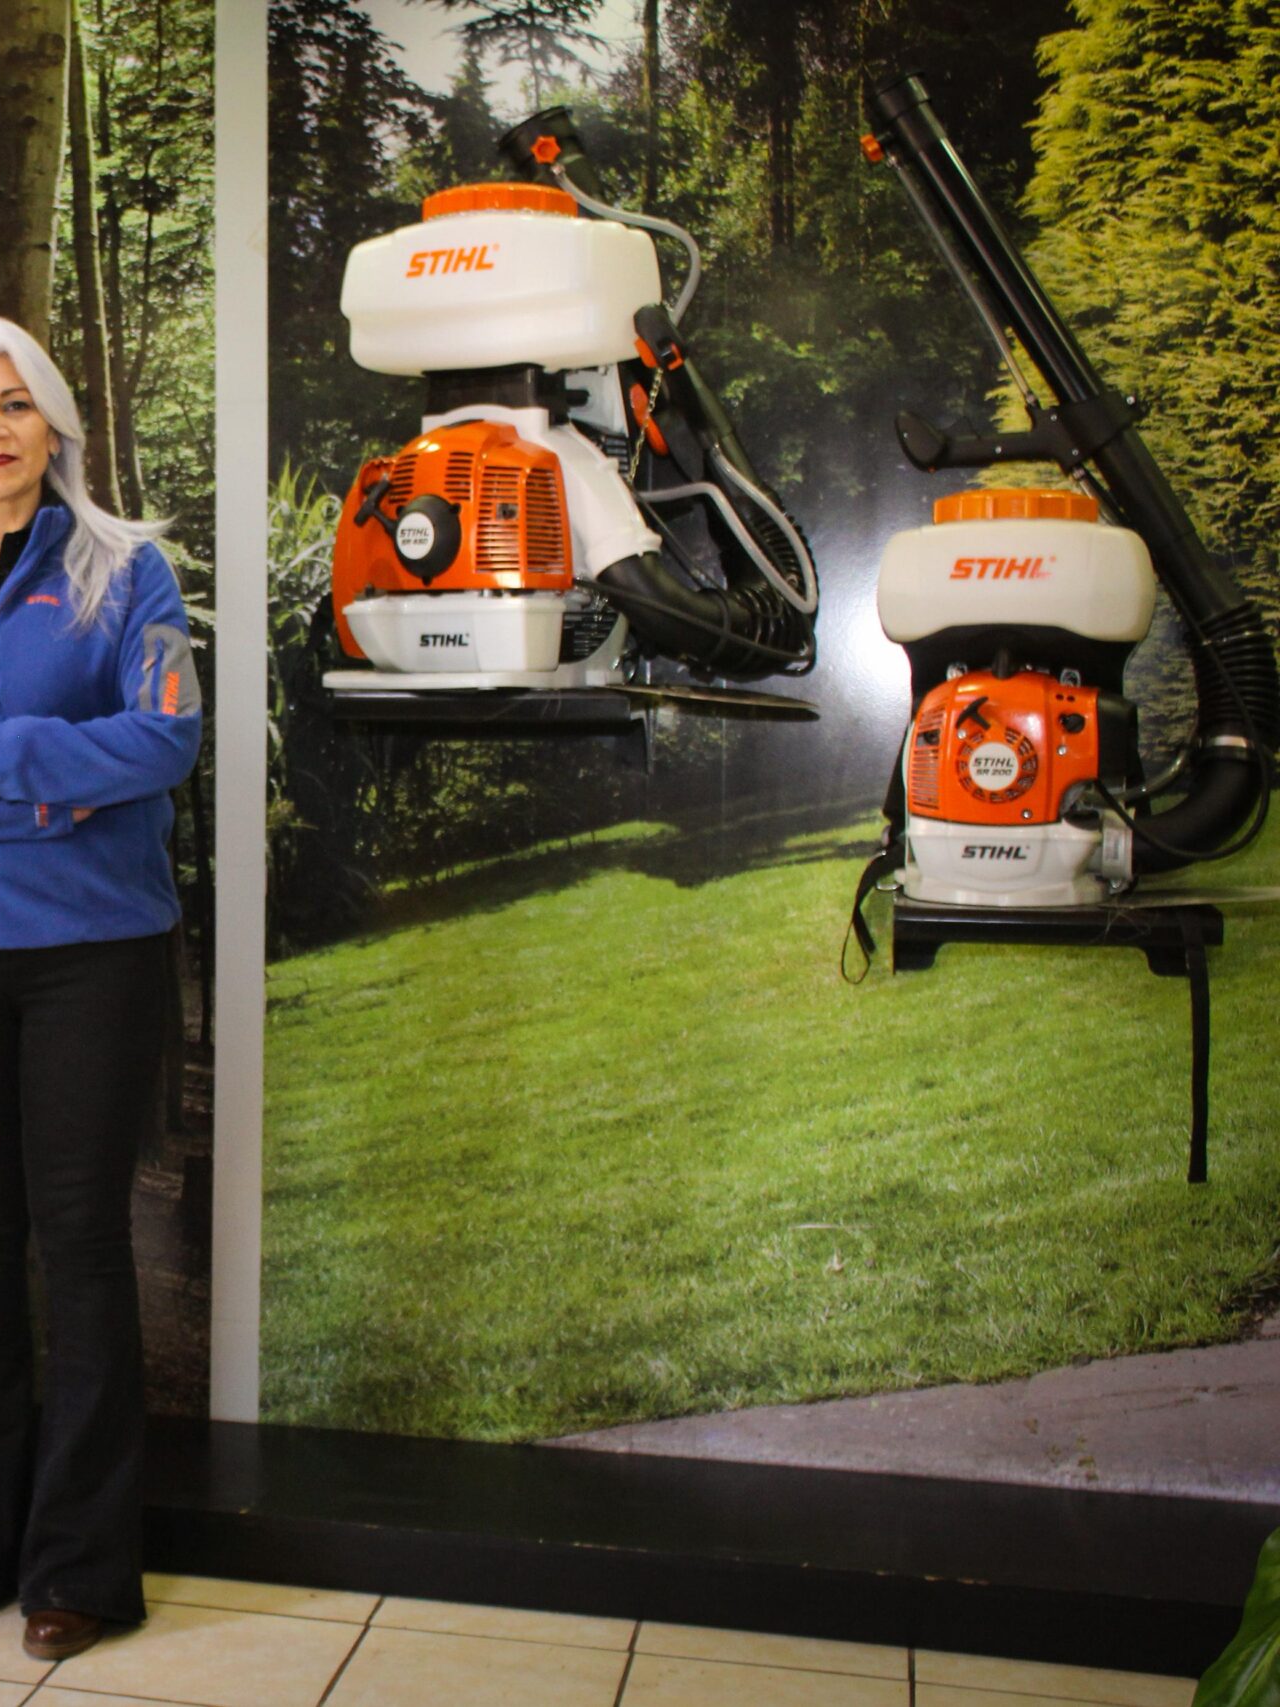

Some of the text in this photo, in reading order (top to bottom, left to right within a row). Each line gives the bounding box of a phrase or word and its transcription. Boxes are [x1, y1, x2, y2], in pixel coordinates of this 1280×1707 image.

[406, 244, 494, 278] STIHL
[400, 528, 429, 537] STIHL
[950, 558, 1051, 579] STIHL
[419, 634, 468, 647] STIHL
[972, 757, 1014, 767] STIHL
[991, 768, 1012, 776] 200
[962, 845, 1027, 859] STIHL
